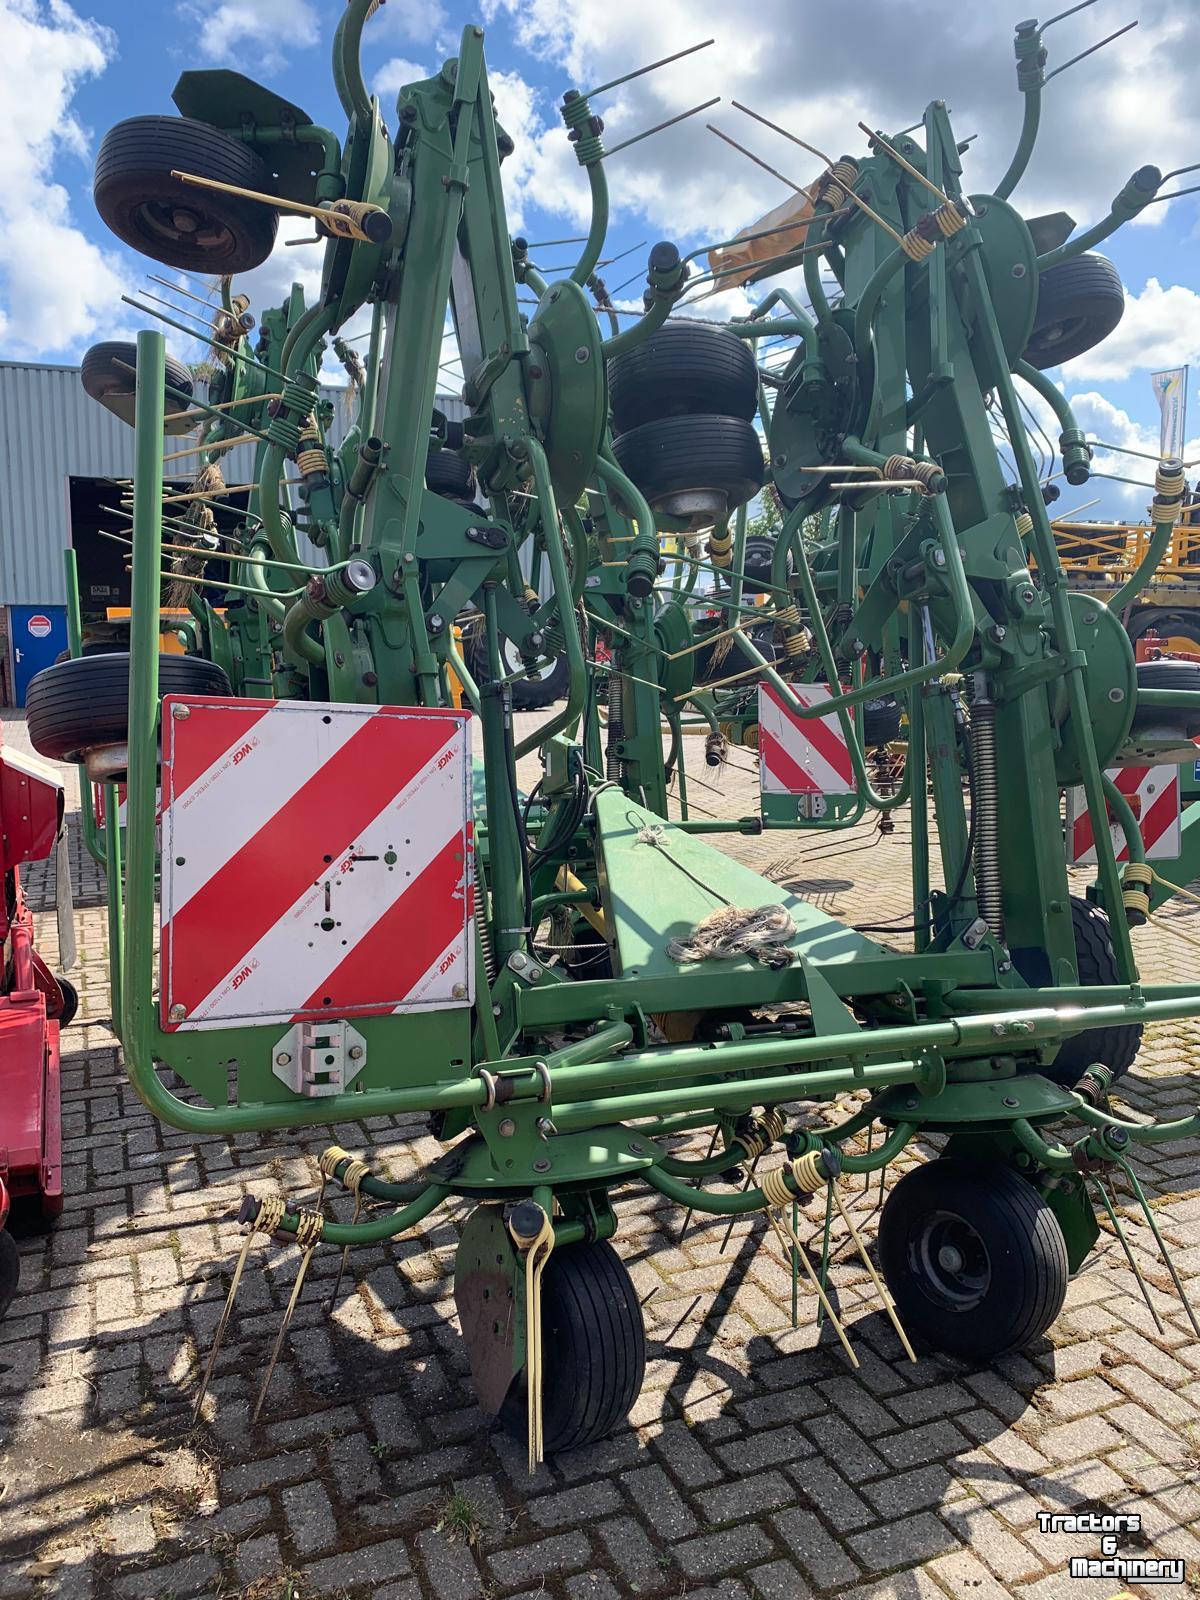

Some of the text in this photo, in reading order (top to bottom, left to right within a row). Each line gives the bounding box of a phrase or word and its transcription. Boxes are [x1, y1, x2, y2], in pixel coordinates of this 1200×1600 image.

[233, 743, 253, 766] WGF
[437, 750, 454, 770] WGF
[439, 952, 457, 975] WGF
[232, 966, 252, 990] WGF
